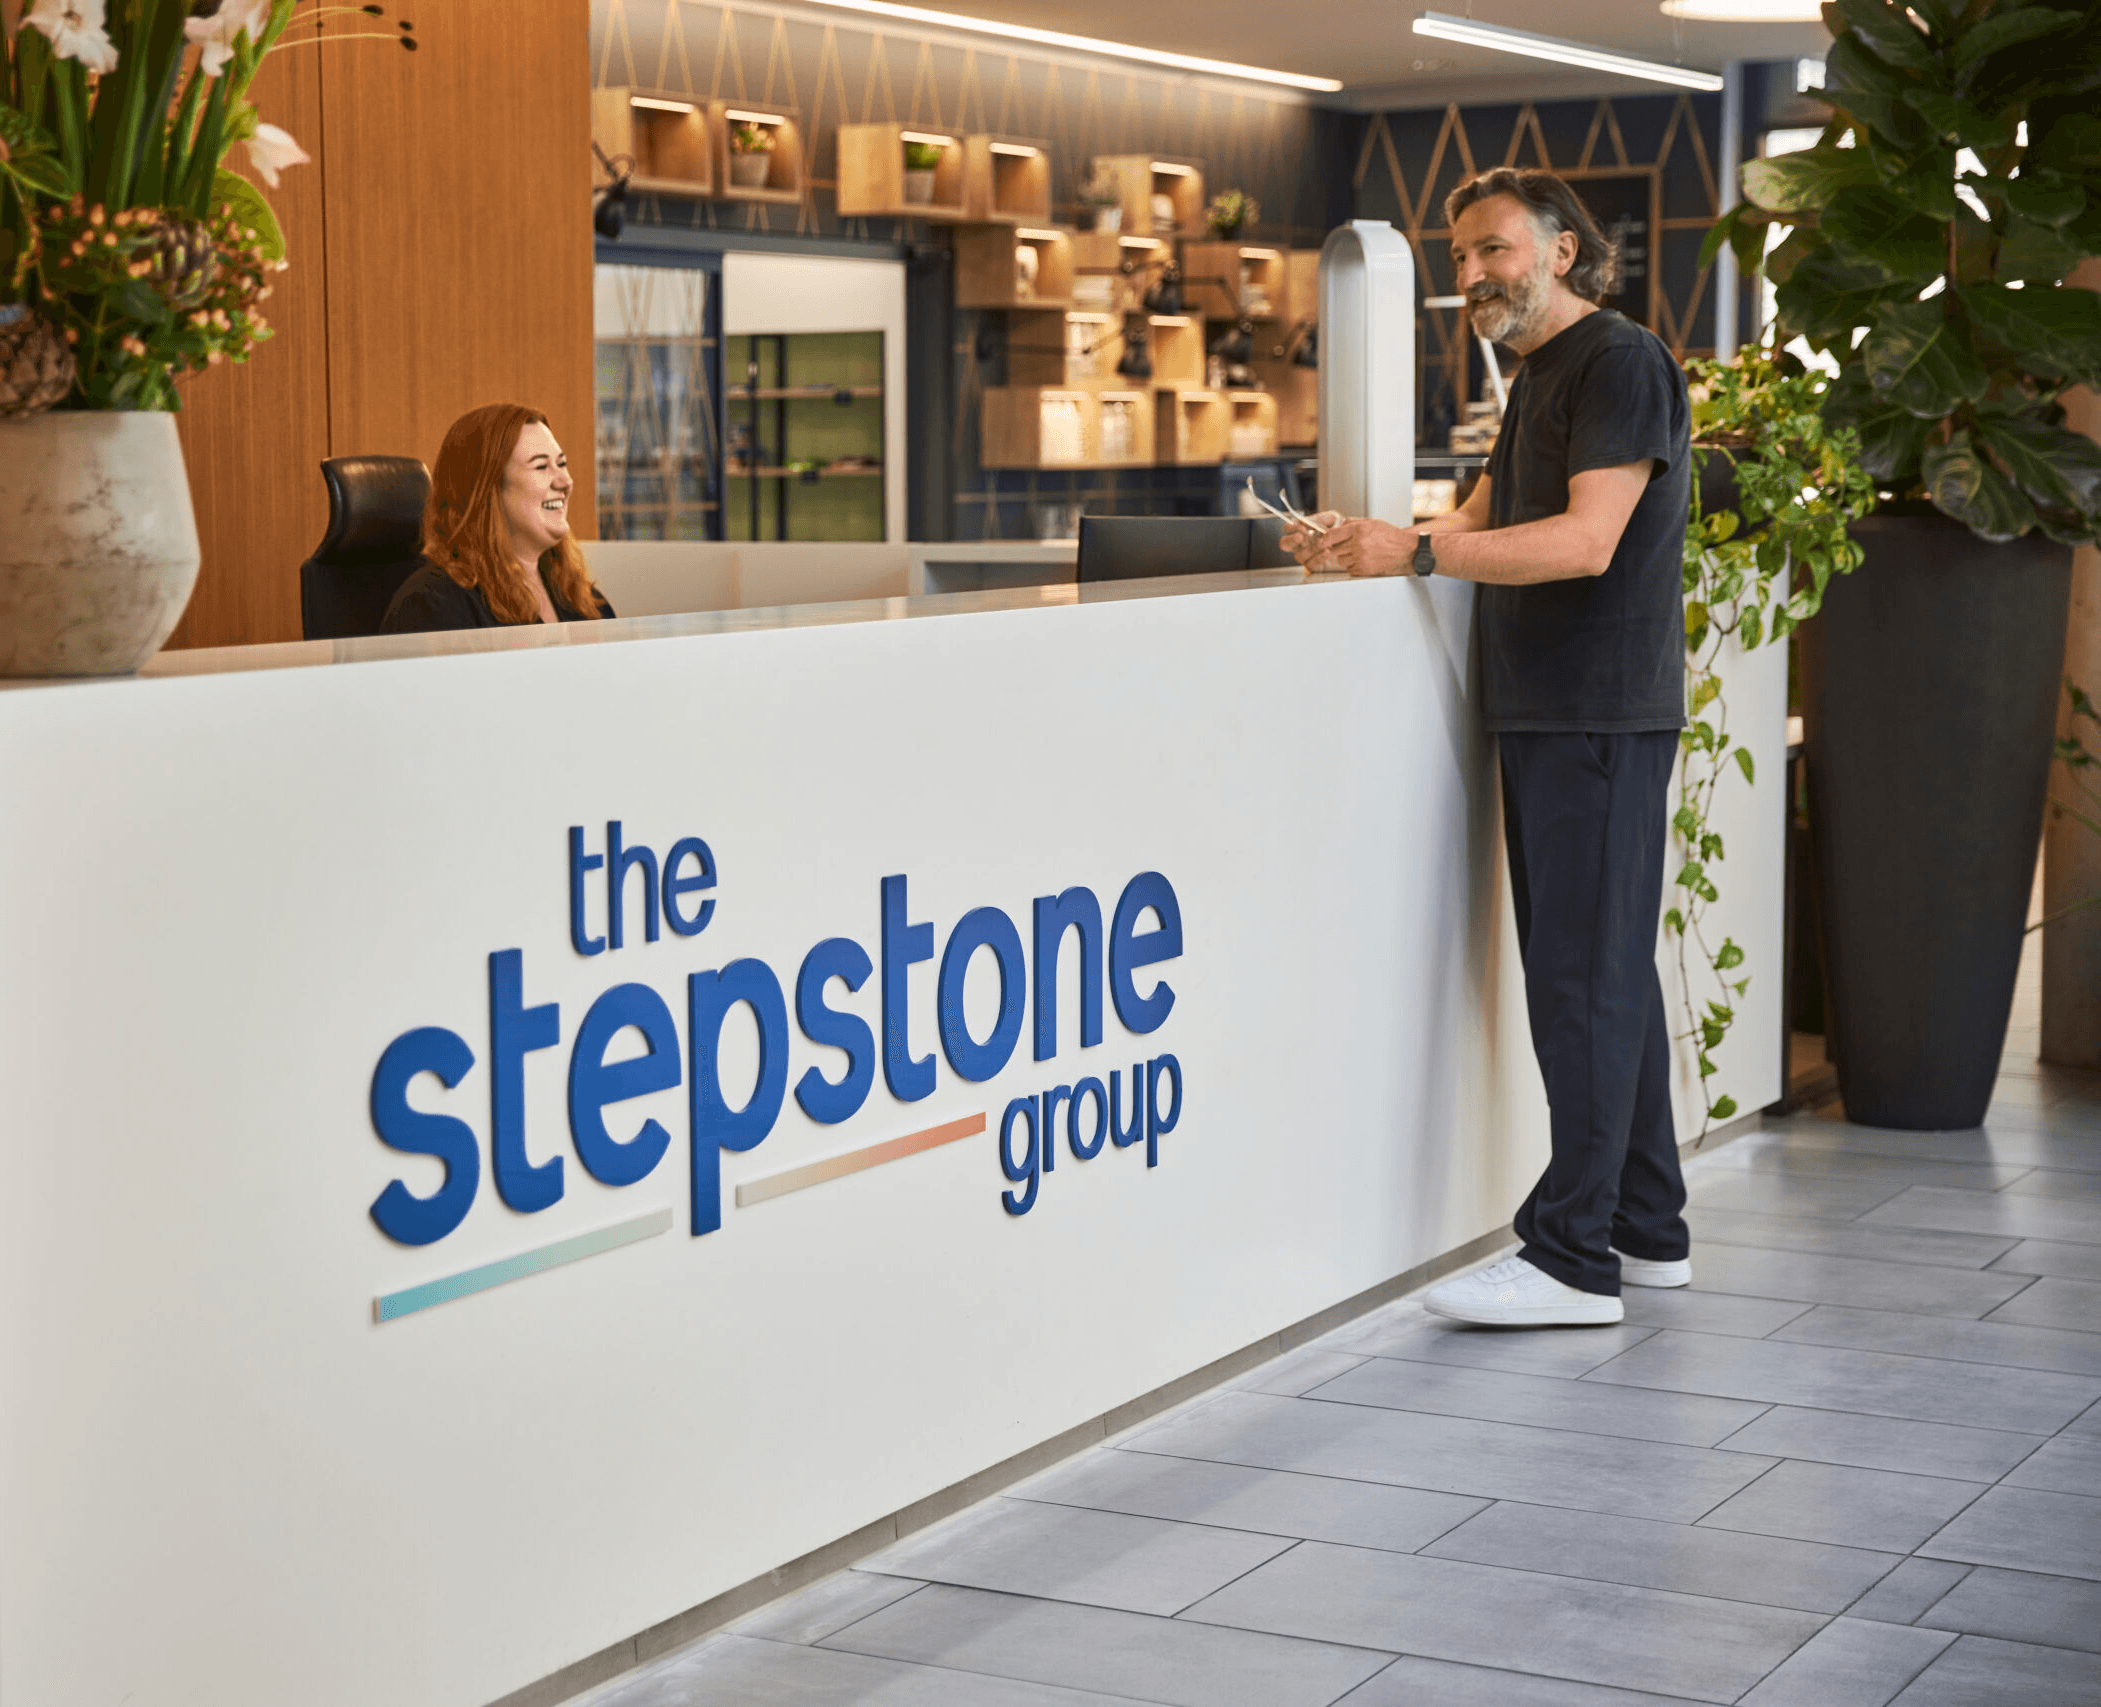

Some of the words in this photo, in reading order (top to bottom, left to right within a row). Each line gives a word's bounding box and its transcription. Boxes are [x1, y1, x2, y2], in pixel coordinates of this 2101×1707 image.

[569, 820, 718, 957] the
[370, 871, 1184, 1246] stepstone
[1000, 1053, 1183, 1216] group
